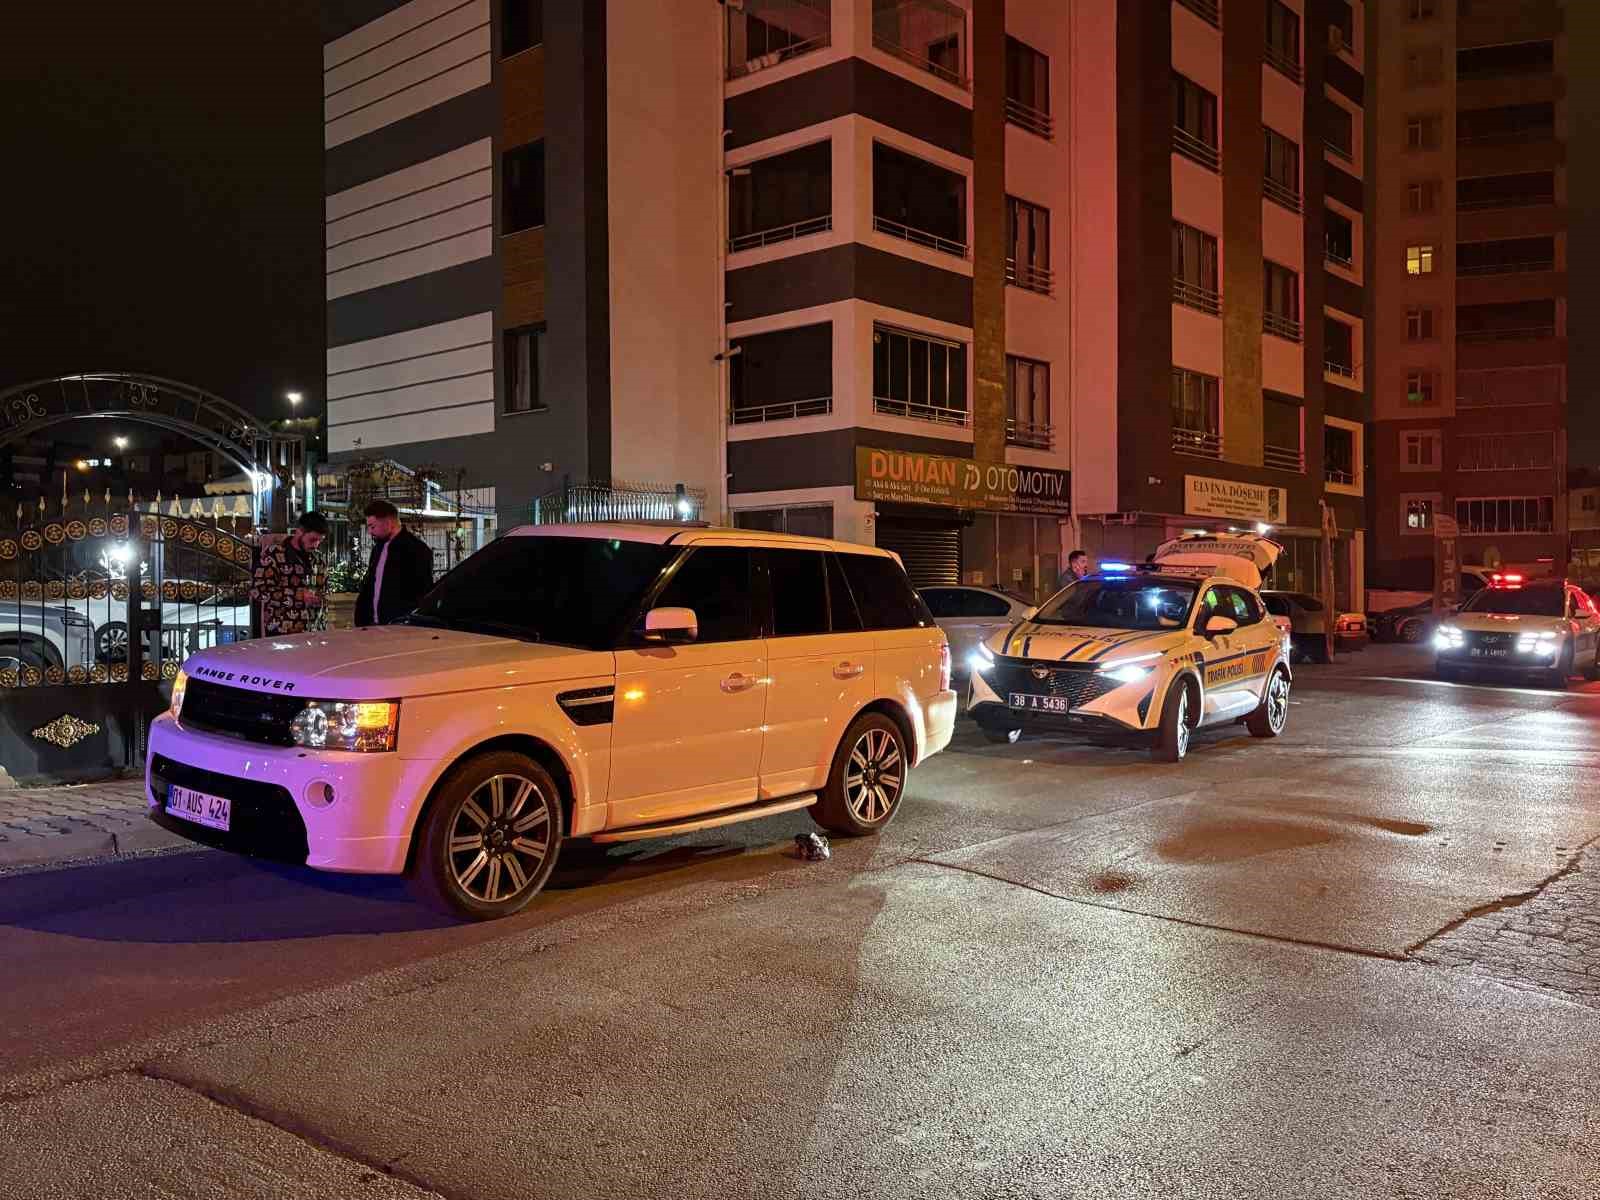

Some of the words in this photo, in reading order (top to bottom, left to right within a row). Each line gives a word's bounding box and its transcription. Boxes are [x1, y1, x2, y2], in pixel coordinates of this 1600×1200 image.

[871, 451, 956, 485] DUMAN
[195, 666, 235, 681] RANGE
[240, 674, 296, 692] ROVER
[1014, 695, 1025, 706] 38
[1031, 696, 1038, 708] A
[1043, 697, 1066, 711] 5436
[172, 788, 183, 809] 01
[187, 792, 204, 815] AUS
[209, 798, 228, 822] 424
